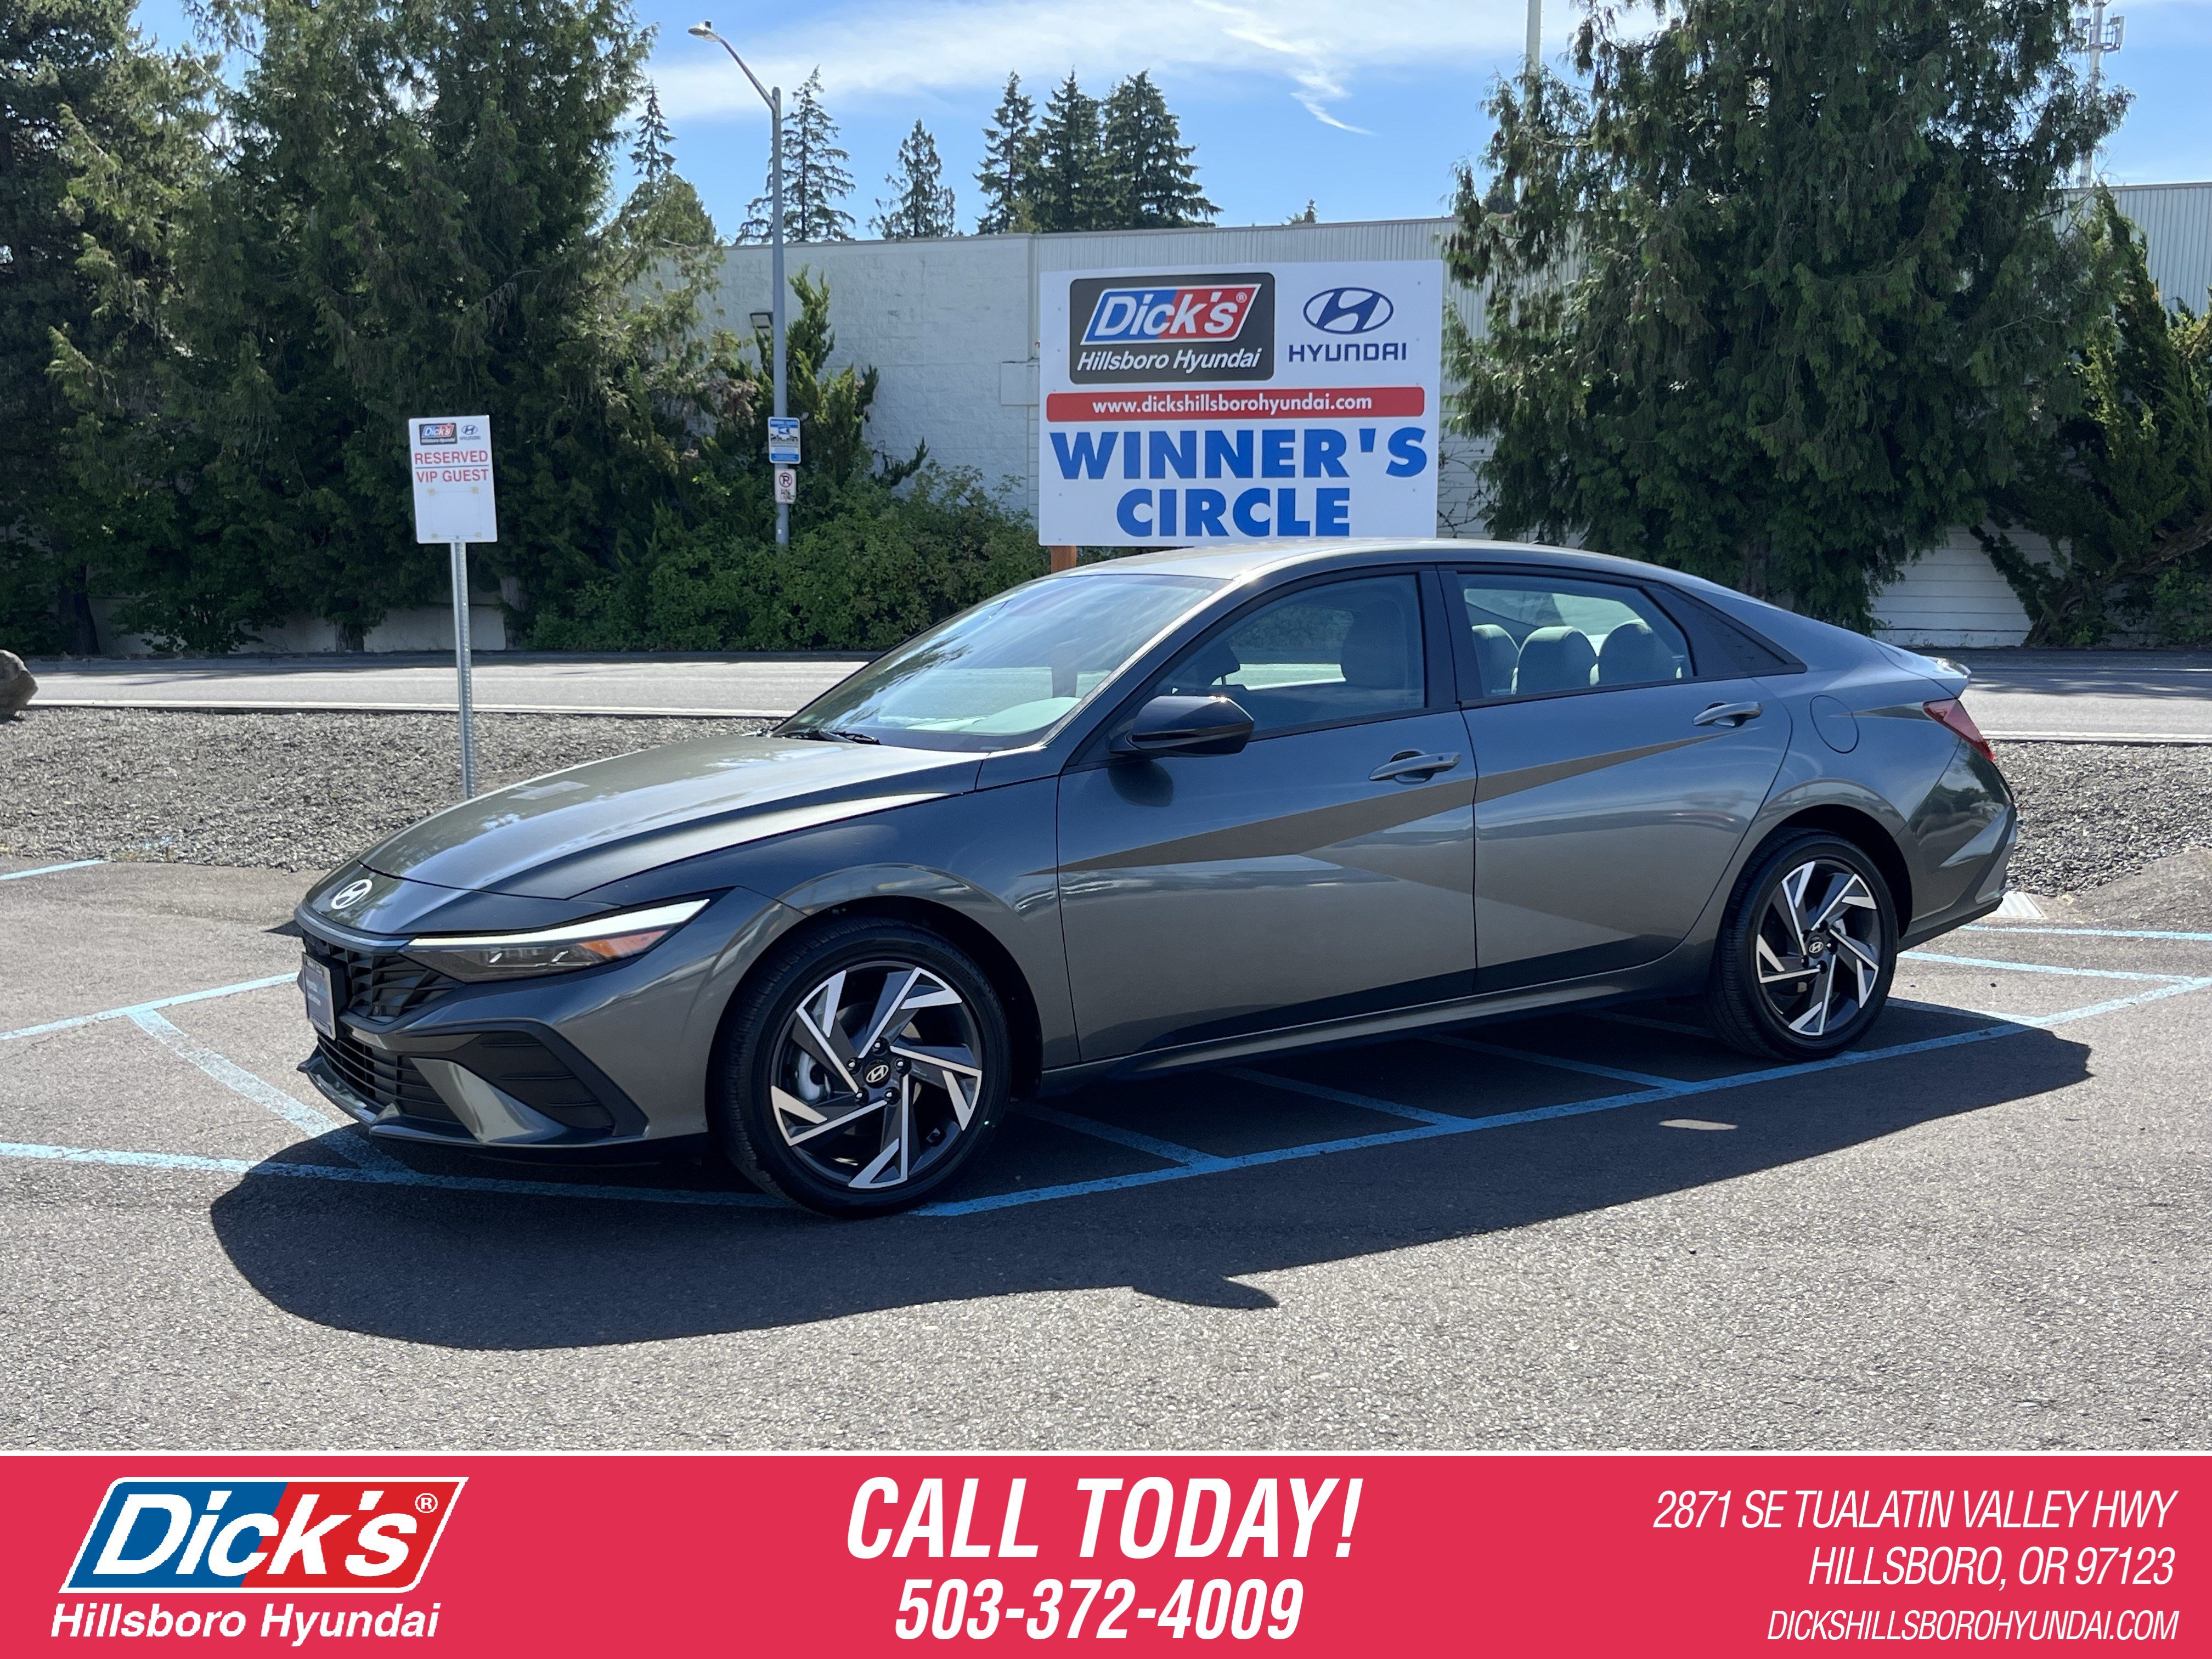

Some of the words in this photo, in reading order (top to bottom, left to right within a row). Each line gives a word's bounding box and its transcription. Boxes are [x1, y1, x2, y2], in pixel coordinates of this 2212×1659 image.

[1094, 292, 1238, 336] Dick's
[1077, 351, 1169, 371] Hillsboro
[1173, 348, 1262, 374] Hyundai
[1289, 343, 1407, 362] HYUNDAI
[1092, 393, 1372, 415] www.dickshillsborohyundai.com
[414, 450, 488, 465] RESERVED
[1049, 427, 1427, 480] WINNER'S
[416, 471, 437, 483] VIP
[442, 469, 489, 482] GUEST
[1116, 487, 1350, 537] CIRCLE
